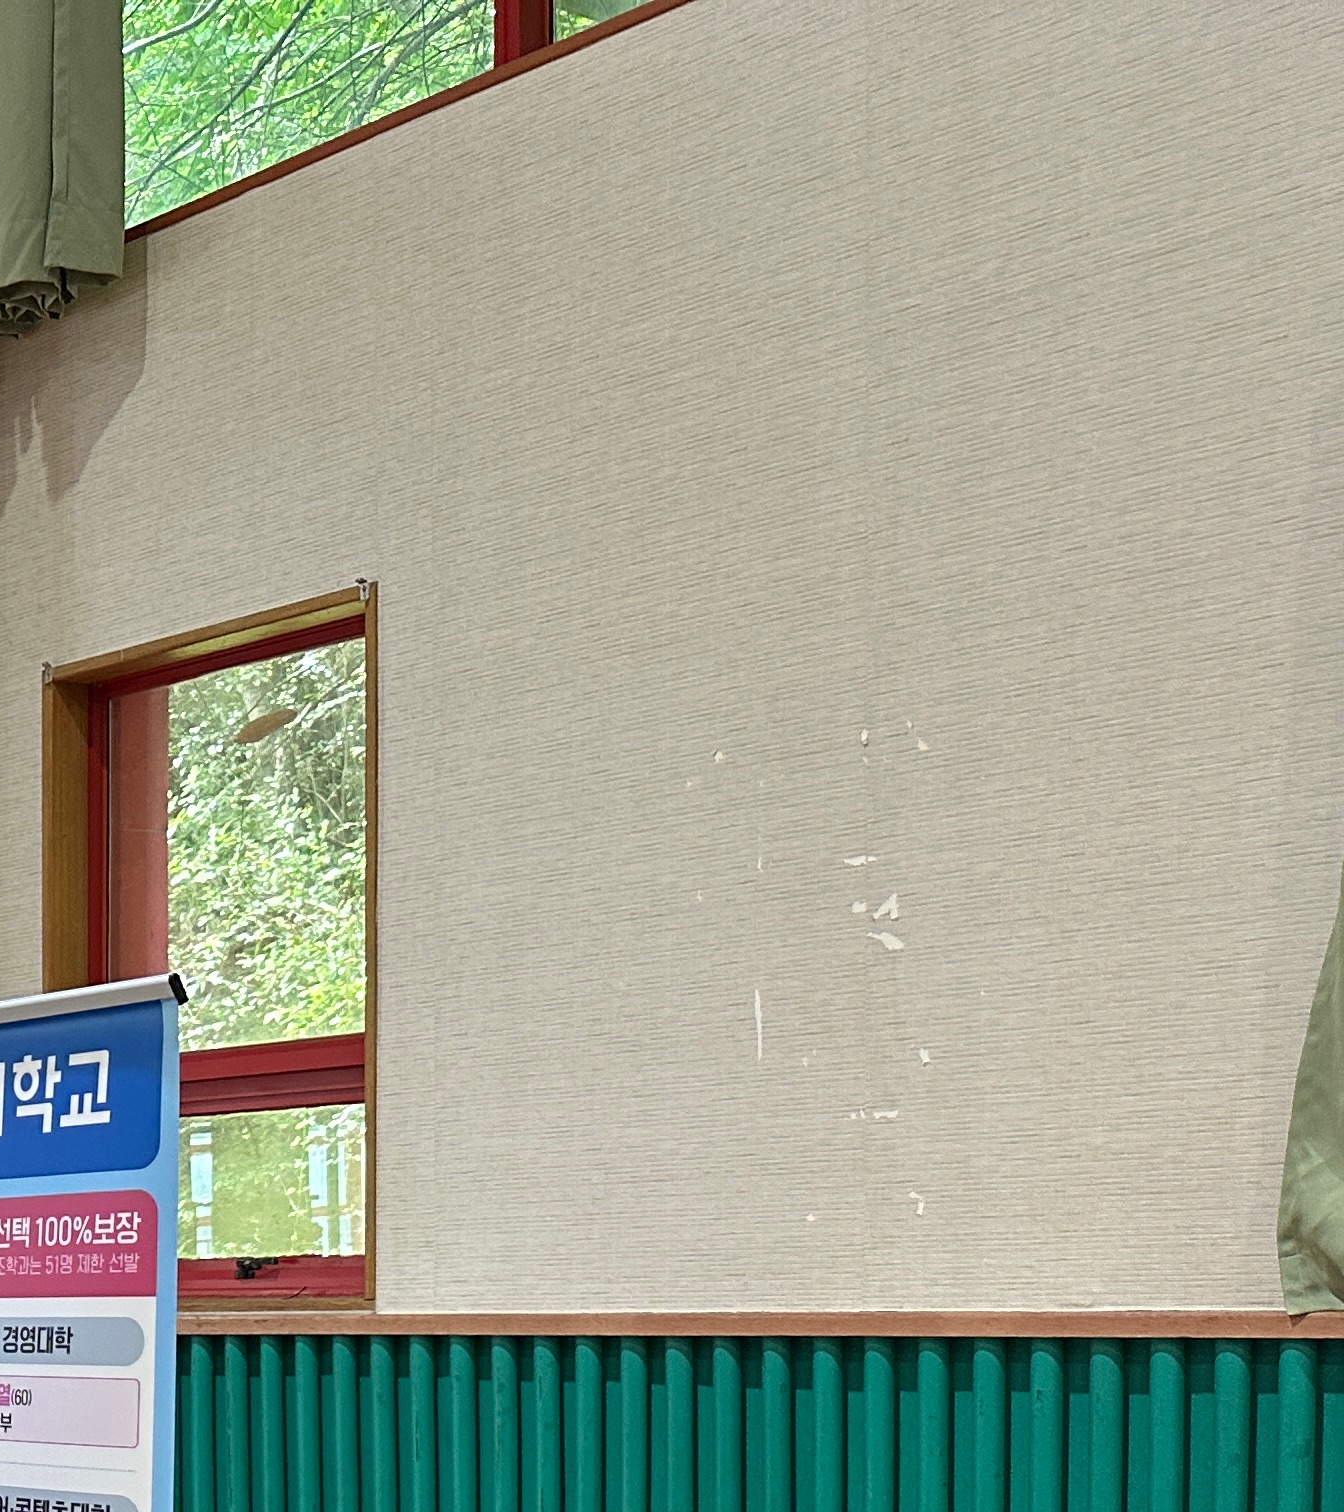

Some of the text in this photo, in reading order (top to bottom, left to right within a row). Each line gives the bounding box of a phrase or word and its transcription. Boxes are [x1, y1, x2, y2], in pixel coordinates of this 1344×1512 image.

[45, 1254, 73, 1275] 51명
[77, 1253, 104, 1274] 제한
[108, 1252, 140, 1273] 선발
[2, 1326, 74, 1354] 경영대학
